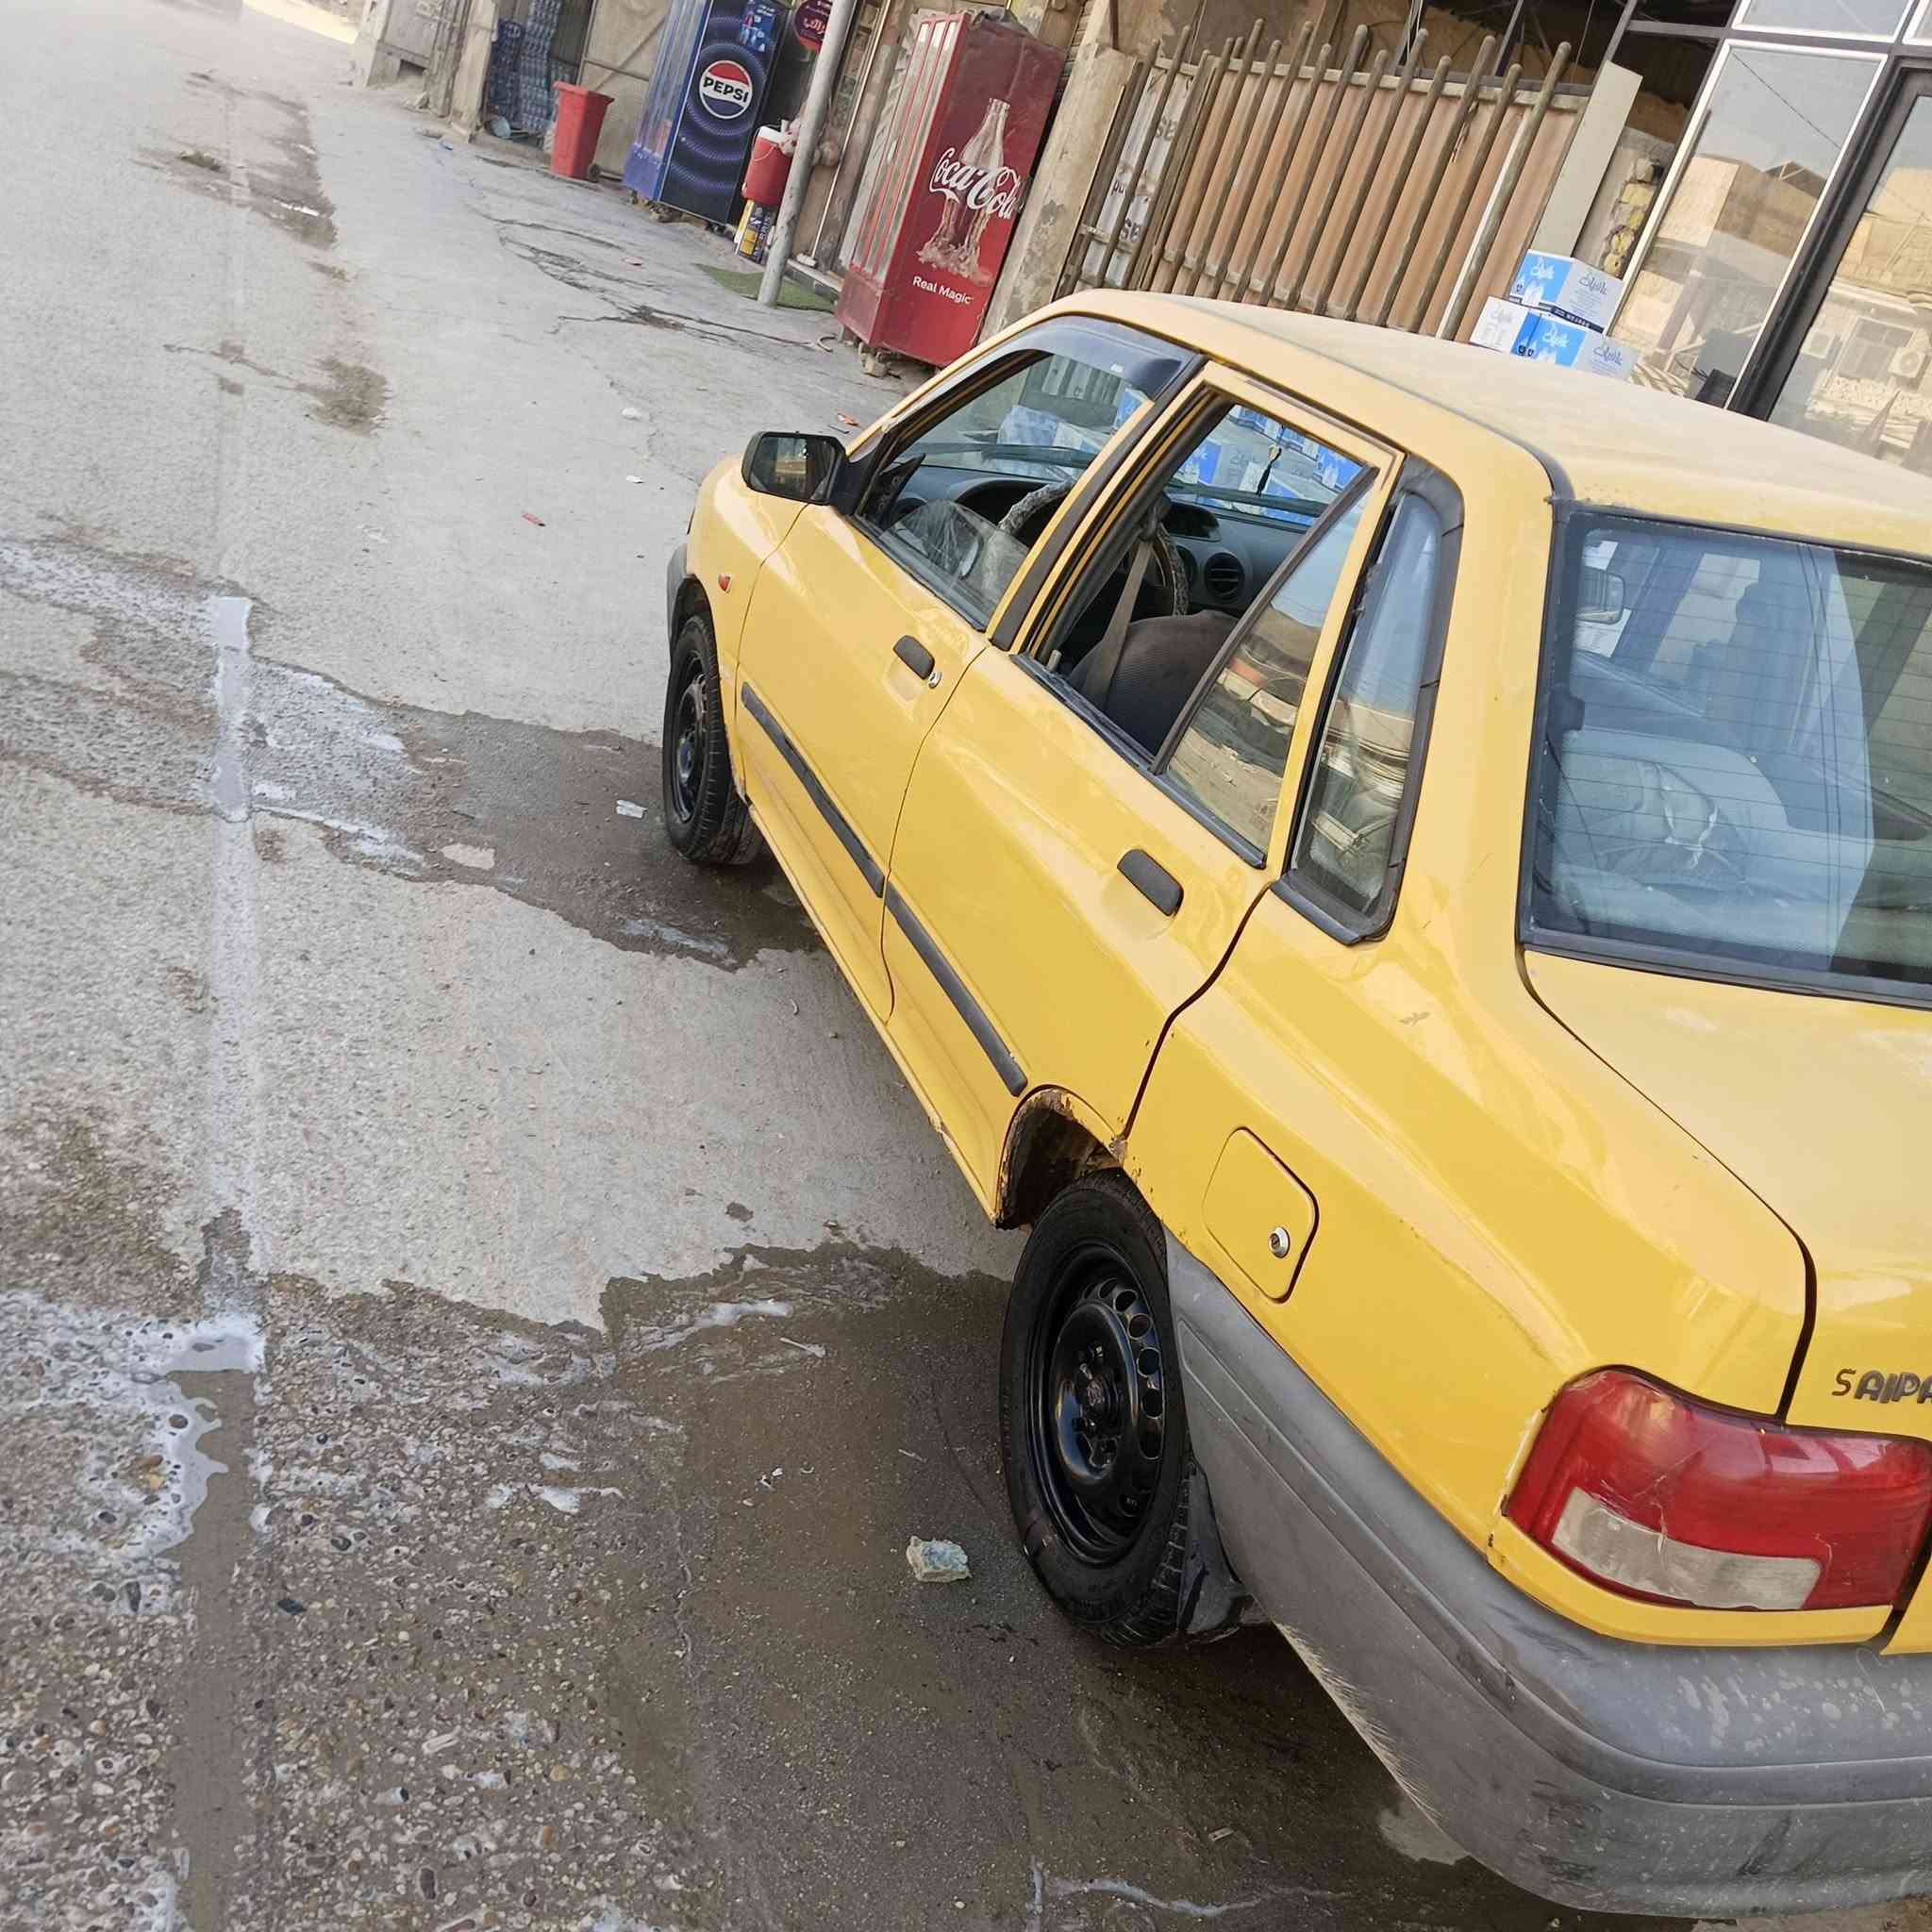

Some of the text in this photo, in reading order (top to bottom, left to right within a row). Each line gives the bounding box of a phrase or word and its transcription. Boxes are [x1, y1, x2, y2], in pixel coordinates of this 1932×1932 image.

[703, 75, 749, 103] PEPSI
[912, 275, 971, 305] Real Magic
